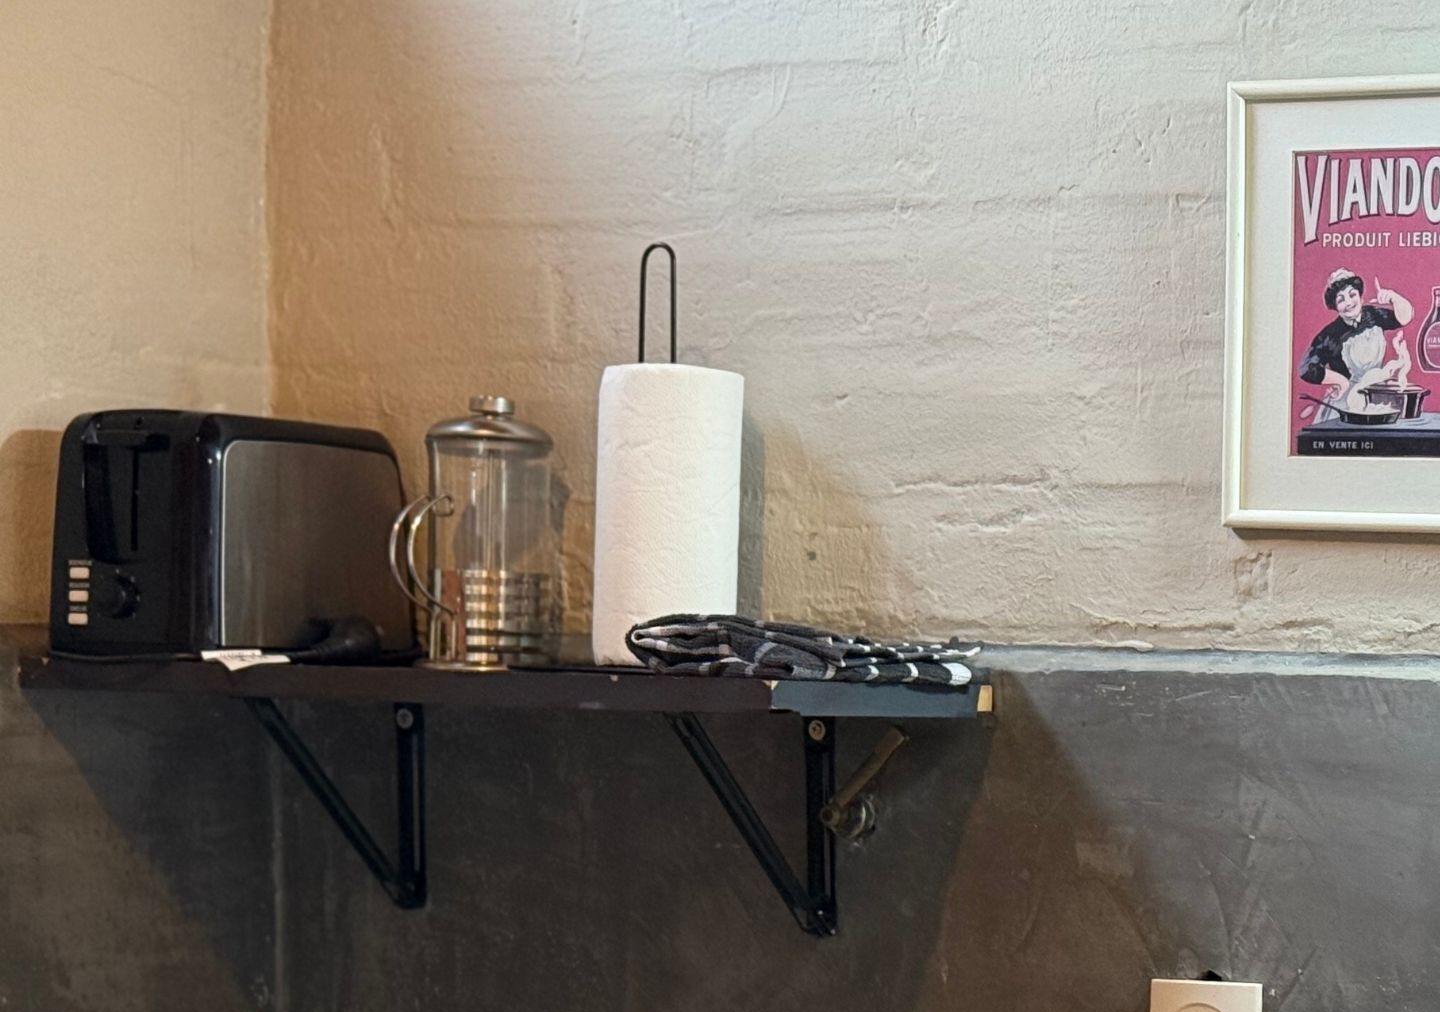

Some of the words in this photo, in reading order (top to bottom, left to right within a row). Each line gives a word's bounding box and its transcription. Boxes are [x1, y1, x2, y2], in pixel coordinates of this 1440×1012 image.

[1322, 232, 1391, 248] PRODUIT
[1312, 441, 1325, 449] EN
[1329, 441, 1358, 449] VENTE
[1361, 441, 1374, 450] ICI
